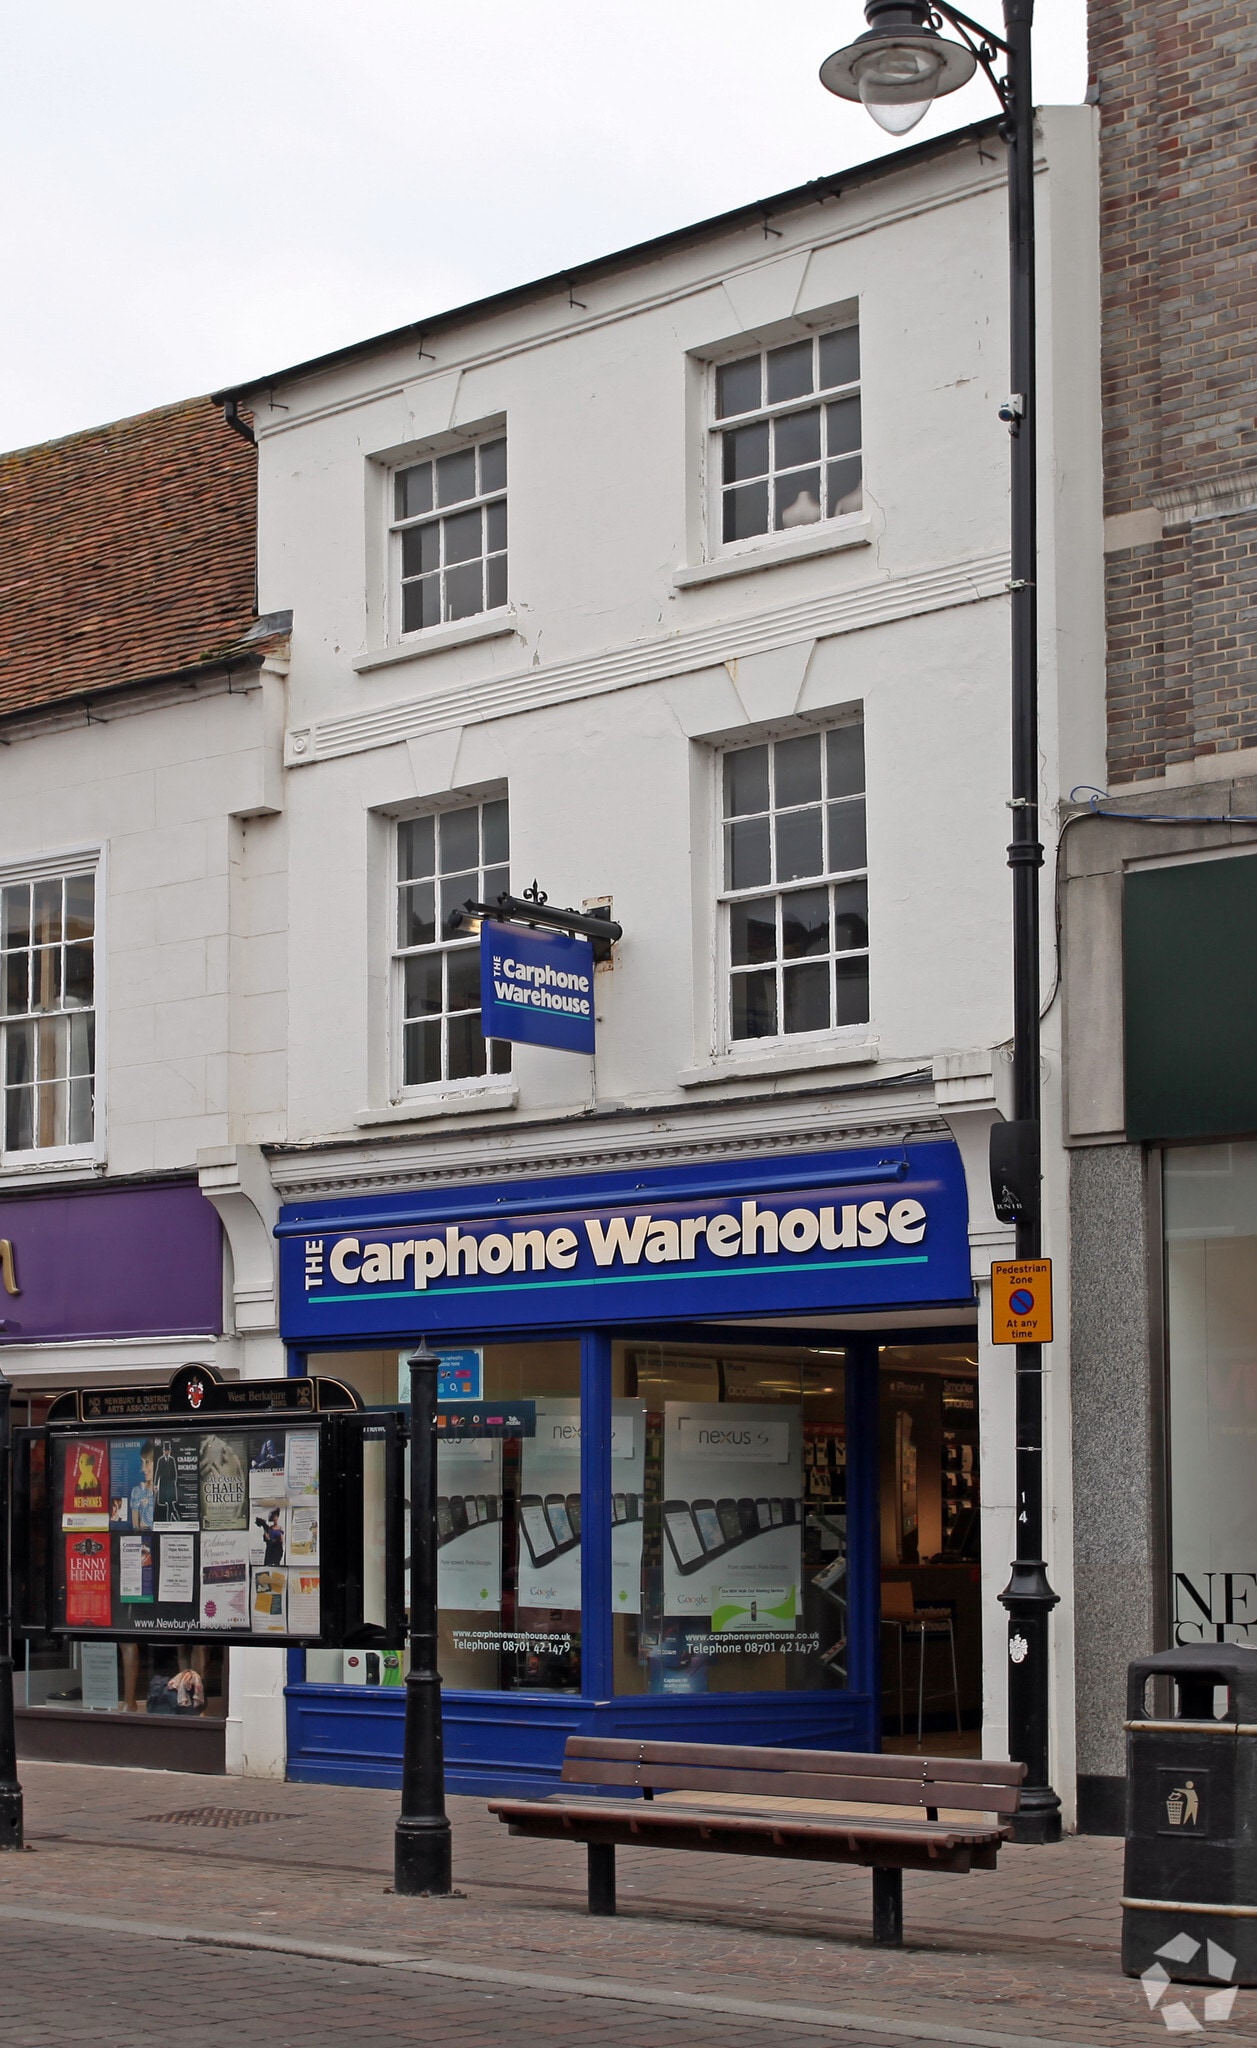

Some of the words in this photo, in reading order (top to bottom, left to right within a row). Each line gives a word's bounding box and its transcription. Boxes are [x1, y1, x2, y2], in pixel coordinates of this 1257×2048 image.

[493, 955, 501, 977] THE
[503, 958, 589, 993] Carphone
[494, 980, 590, 1015] Warehouse
[304, 1239, 324, 1290] THE
[329, 1226, 578, 1290] Carphone
[584, 1198, 927, 1267] Warehouse
[996, 1264, 1047, 1275] Pedestrian
[1009, 1276, 1033, 1285] Zone
[1006, 1319, 1018, 1328] At
[1020, 1320, 1038, 1329] any
[1011, 1330, 1033, 1339] time
[104, 1397, 135, 1405] NEWBURY
[143, 1395, 171, 1404] DISTRICT
[227, 1391, 246, 1401] West
[249, 1389, 286, 1401] Berkshire
[107, 1405, 124, 1413] ARTS
[126, 1404, 169, 1413] ASSOCIATION
[699, 1429, 751, 1445] nexus
[203, 1483, 244, 1494] CHALK
[204, 1494, 243, 1504] CIRCLE
[70, 1558, 107, 1570] LENNY
[70, 1570, 107, 1581] HENRY
[530, 1586, 557, 1599] Google
[677, 1594, 708, 1607] Google
[1172, 1572, 1257, 1625] NE
[452, 1630, 571, 1641] www.carphonewarehouse.co.uk
[685, 1631, 820, 1642] www.carphonewarehouse.co.uk
[453, 1638, 500, 1651] Telephone
[502, 1641, 530, 1653] 08701
[533, 1641, 546, 1654] 42
[547, 1641, 571, 1655] 1479
[687, 1643, 742, 1656] Telephone
[744, 1643, 776, 1656] 08701
[779, 1642, 792, 1654] 42
[795, 1641, 819, 1654] 1479
